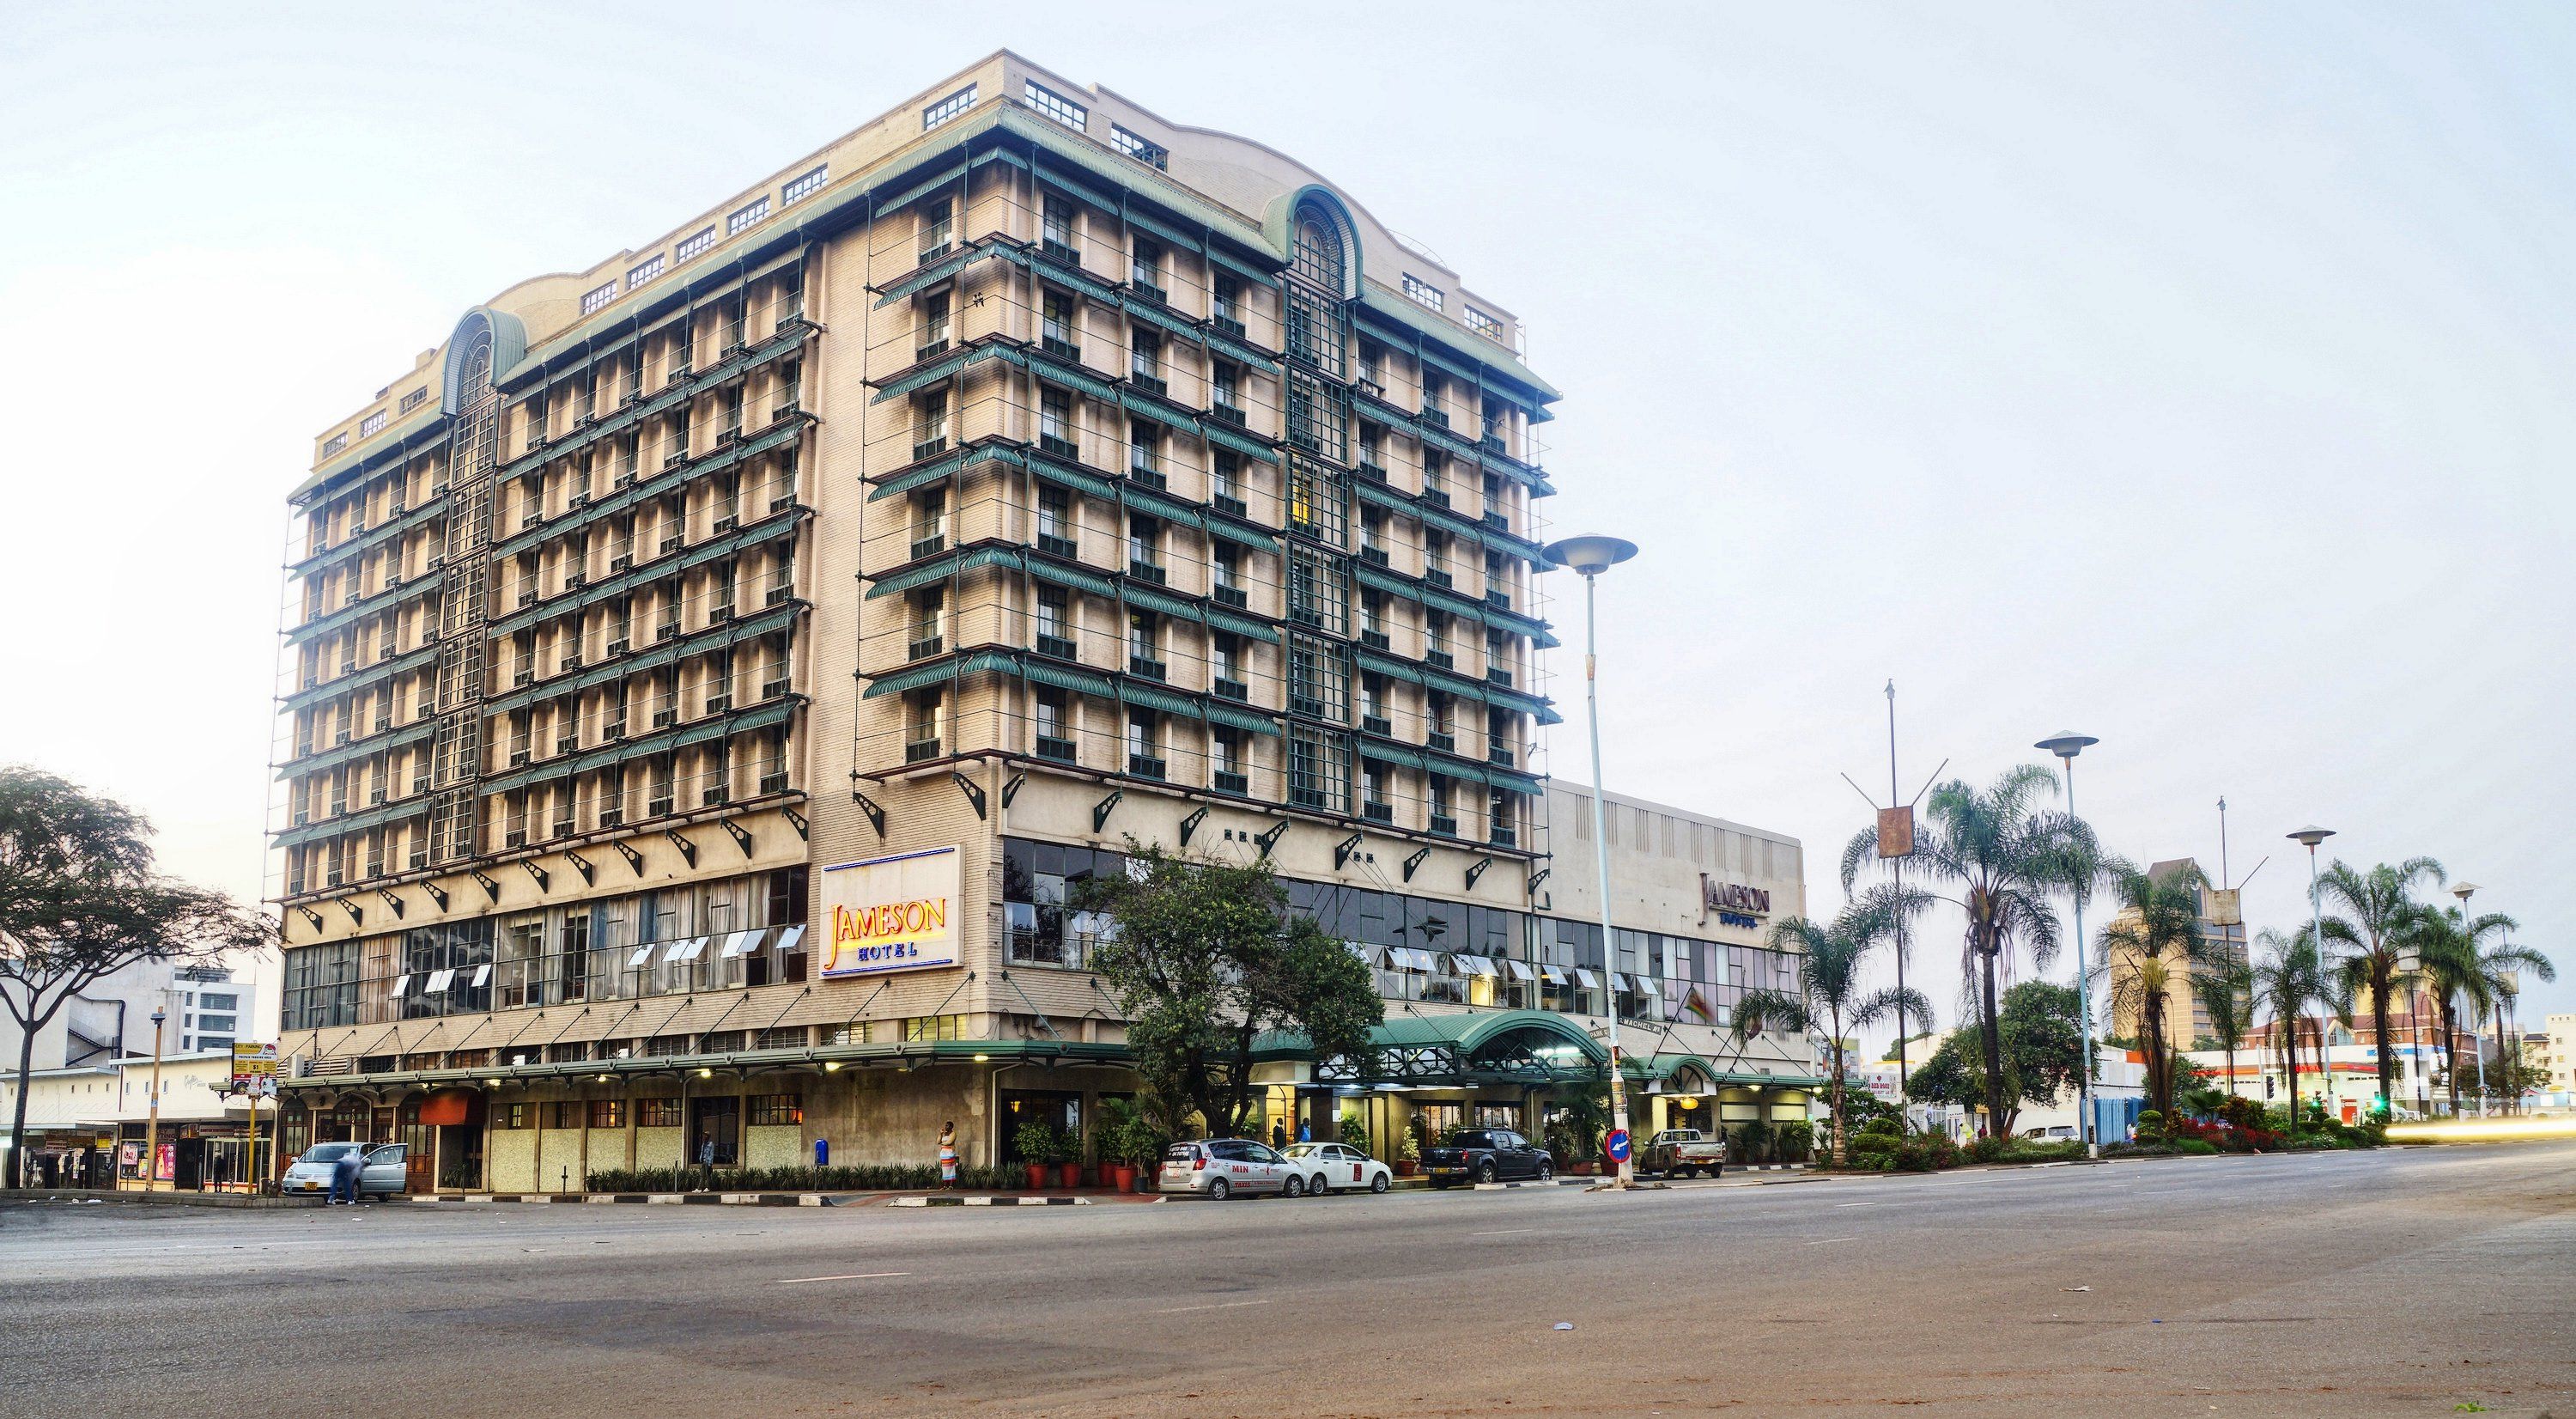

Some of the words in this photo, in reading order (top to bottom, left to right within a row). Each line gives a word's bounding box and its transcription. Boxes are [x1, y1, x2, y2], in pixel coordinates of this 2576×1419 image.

[1698, 872, 1770, 927] JAMESON
[824, 898, 946, 970] JAMESON
[857, 941, 918, 961] HOTEL
[1624, 1019, 1651, 1031] MACHEL
[1231, 1165, 1249, 1173] MIN
